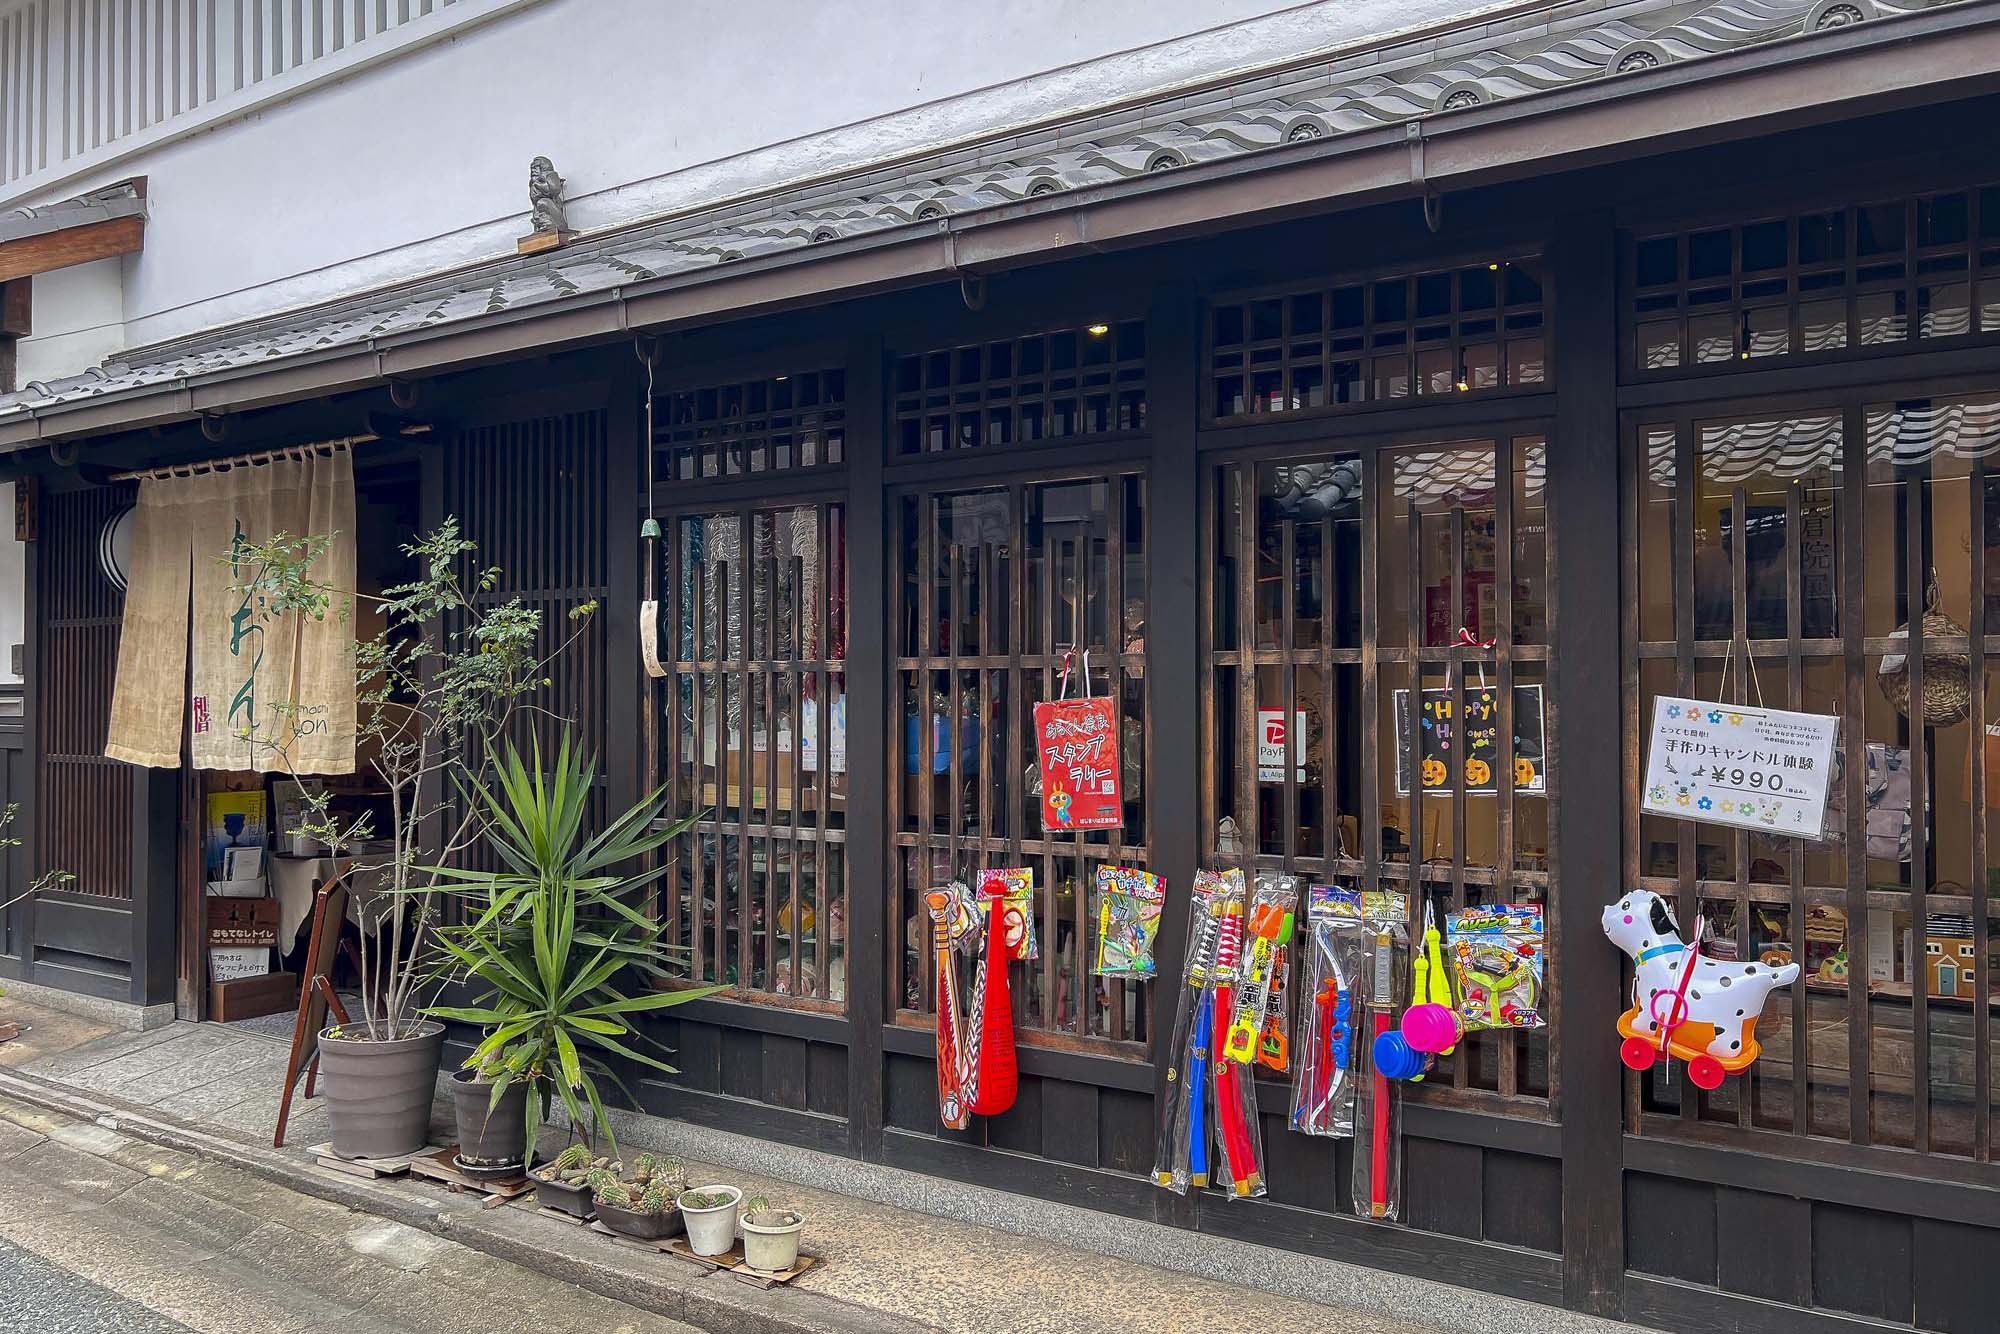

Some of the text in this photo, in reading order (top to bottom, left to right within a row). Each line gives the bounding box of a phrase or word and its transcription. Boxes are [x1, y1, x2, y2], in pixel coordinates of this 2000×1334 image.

[1434, 699, 1491, 721] Hppy
[1435, 723, 1499, 739] Howee
[1045, 733, 1105, 770] スタンプ
[1260, 746, 1285, 758] PayP
[1665, 738, 1815, 771] 手作りキャンドル体験
[1069, 765, 1112, 792] ラリー
[1711, 765, 1784, 791] ¥990
[212, 929, 274, 938] おもてなしトイレ
